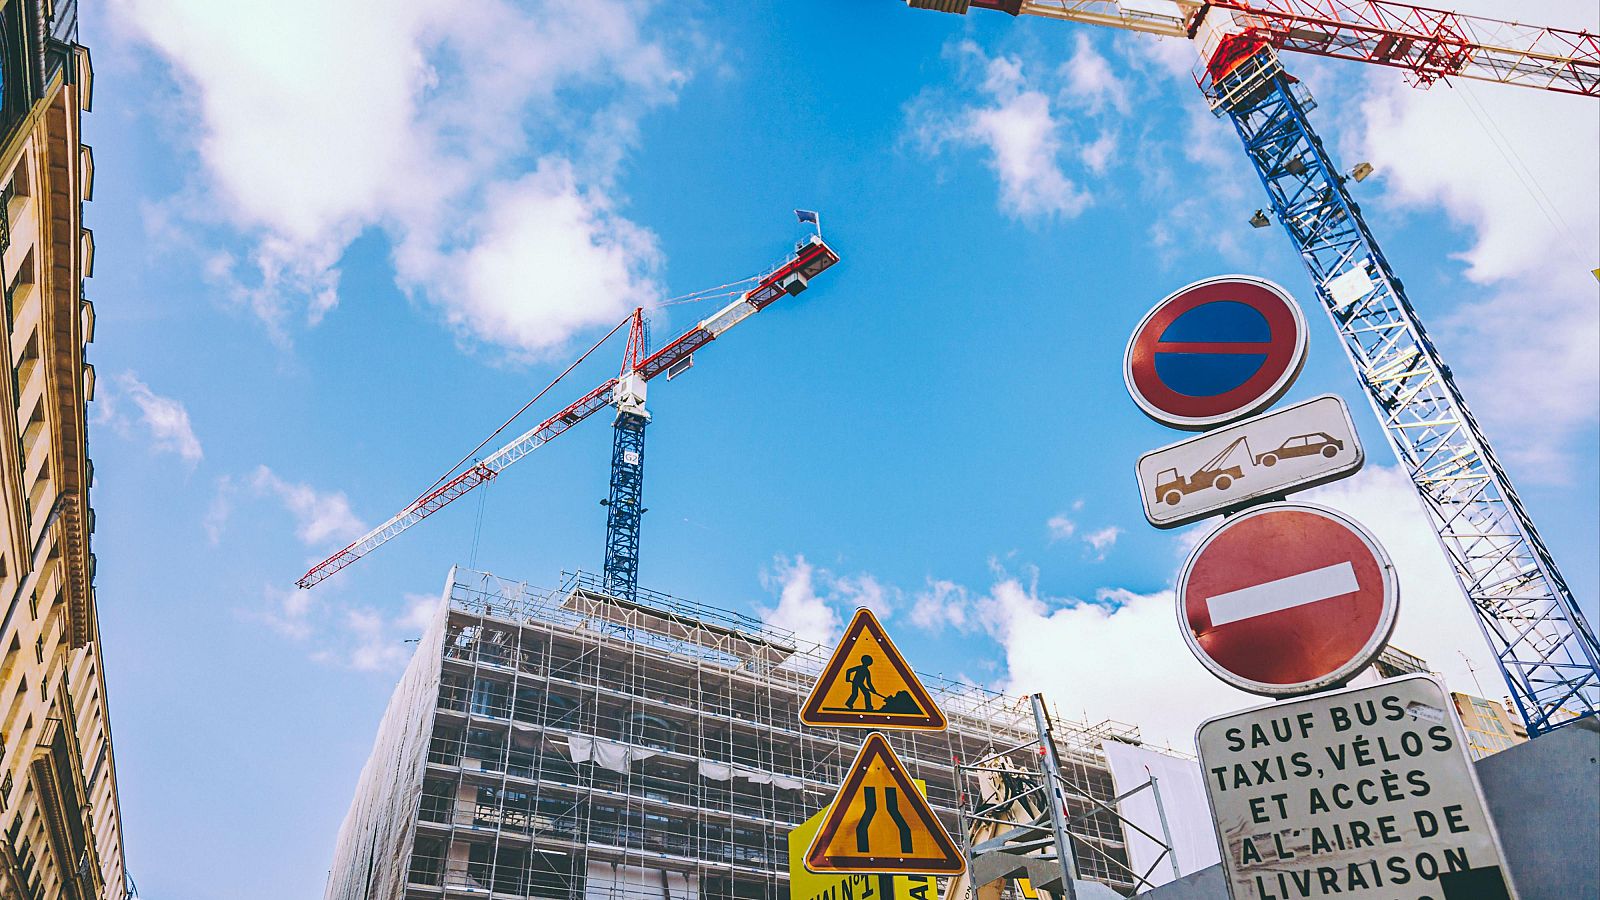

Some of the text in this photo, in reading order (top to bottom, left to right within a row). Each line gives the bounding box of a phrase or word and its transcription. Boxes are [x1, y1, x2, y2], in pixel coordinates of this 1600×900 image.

[1226, 712, 1315, 753] SAUF
[1330, 695, 1418, 732] BUS,
[1249, 768, 1431, 823] ET ACCÈS
[1242, 804, 1470, 865] A L'AIRE DE
[1255, 846, 1471, 900] LIVRAISON
